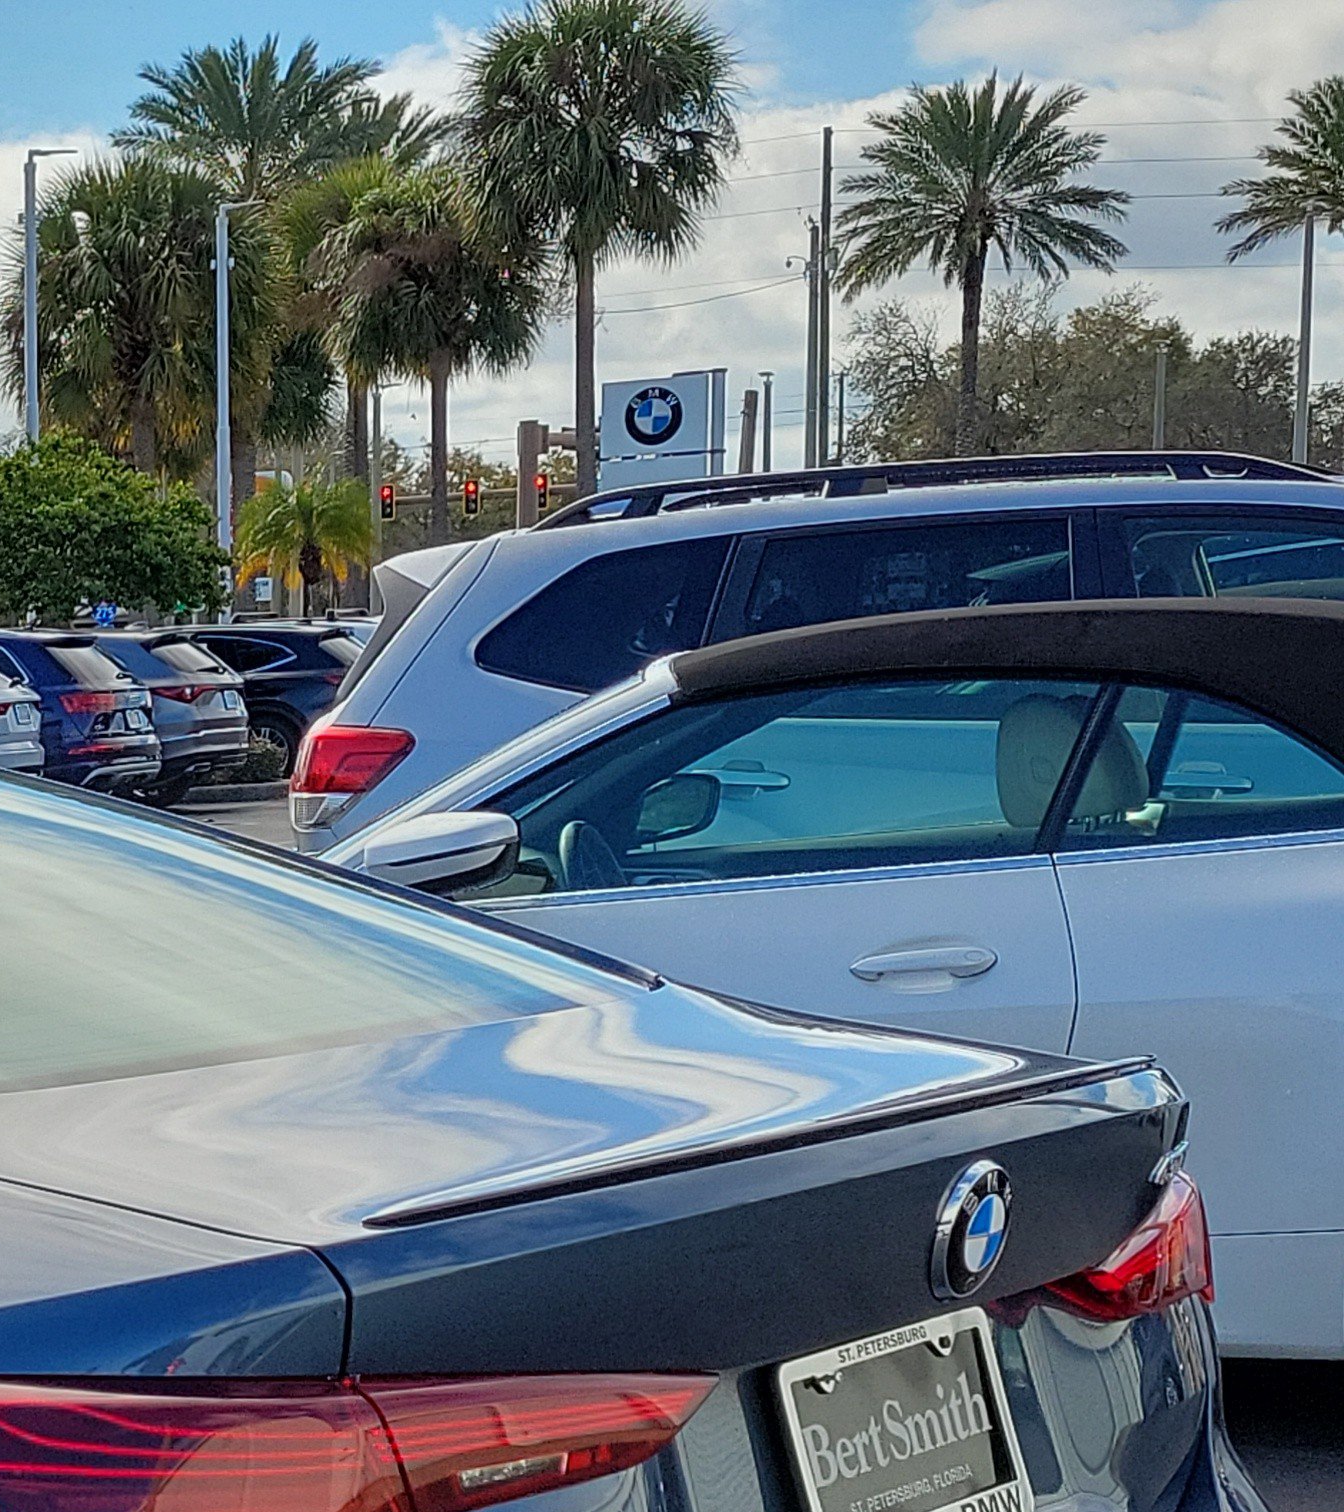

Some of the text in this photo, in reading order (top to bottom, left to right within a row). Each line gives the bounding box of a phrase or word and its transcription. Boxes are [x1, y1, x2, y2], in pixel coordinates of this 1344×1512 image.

[96, 606, 115, 619] 275
[962, 1170, 1013, 1215] BMW
[838, 1326, 928, 1364] ST. PETERSBURG
[934, 1463, 974, 1491] FLORIDA
